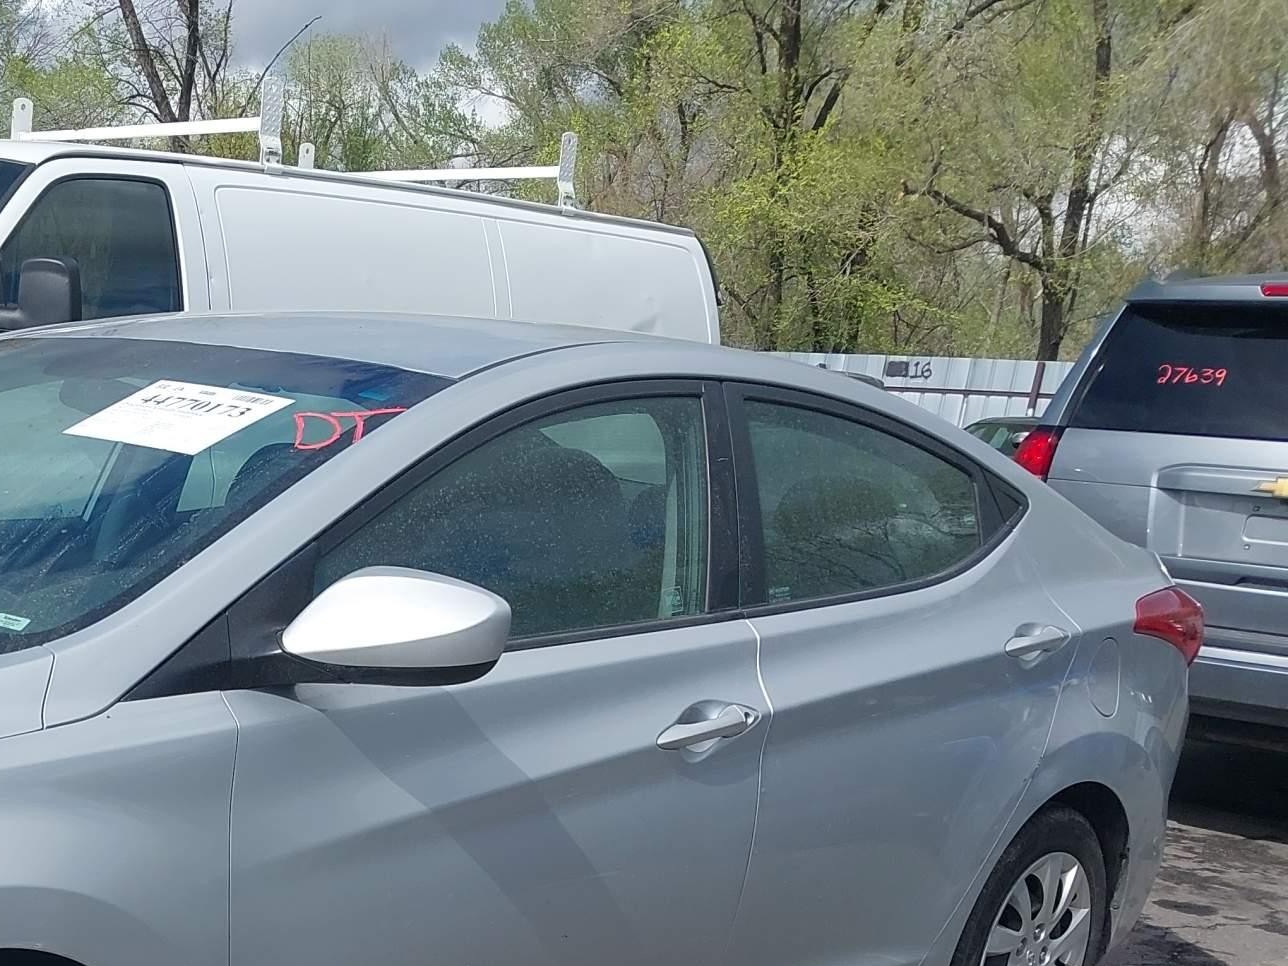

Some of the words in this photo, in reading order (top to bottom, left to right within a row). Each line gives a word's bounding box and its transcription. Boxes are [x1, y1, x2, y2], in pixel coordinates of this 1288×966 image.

[1157, 364, 1227, 386] 27639
[140, 393, 253, 418] 44770173
[294, 407, 407, 450] DT
